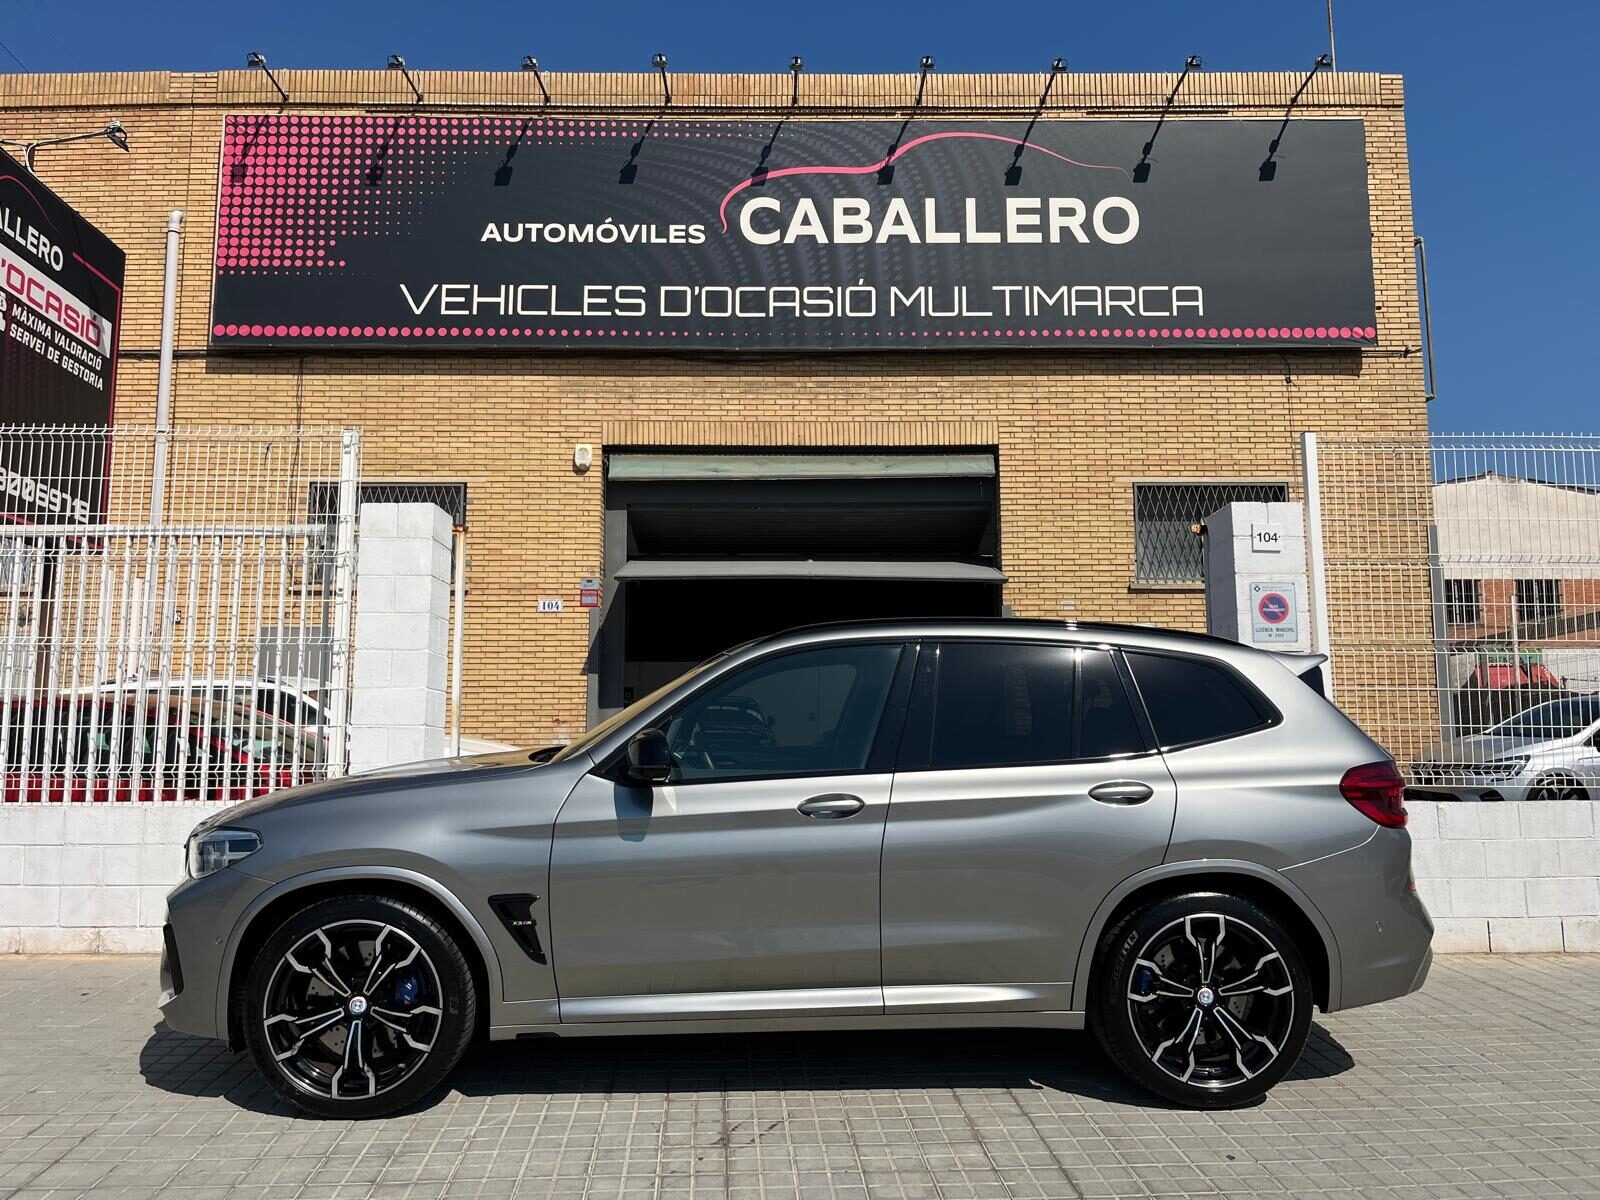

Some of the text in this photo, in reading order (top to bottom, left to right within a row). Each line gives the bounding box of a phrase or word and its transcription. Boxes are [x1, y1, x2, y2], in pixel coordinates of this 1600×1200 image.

[480, 195, 1140, 245] AUTOMÓVILES CABALLERO
[399, 278, 1204, 318] VEHICLES D'OCASIÓ MULTIMARCA
[10, 323, 103, 391] SERVEI DE GESTORIA
[12, 303, 51, 339] MÀXIMA
[54, 330, 102, 371] VALORACIÓ
[1256, 532, 1278, 543] 104
[542, 601, 560, 611] 104
